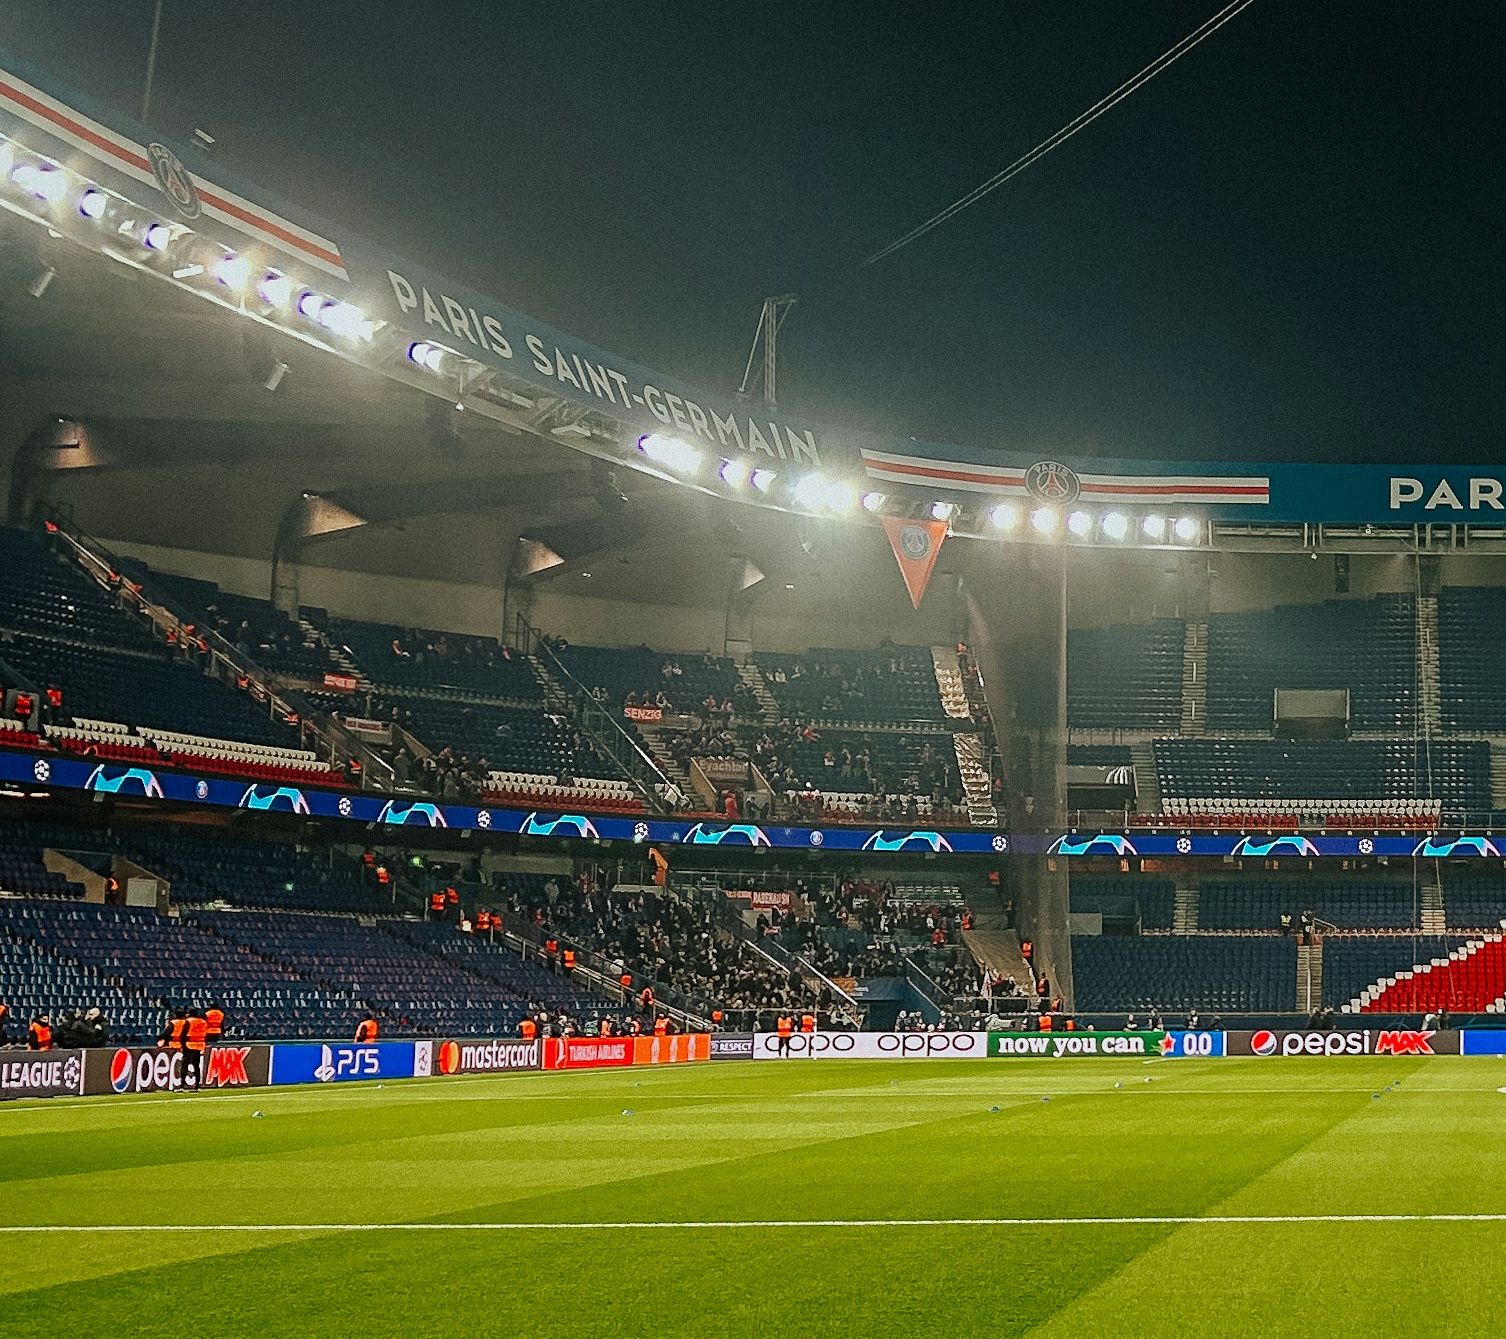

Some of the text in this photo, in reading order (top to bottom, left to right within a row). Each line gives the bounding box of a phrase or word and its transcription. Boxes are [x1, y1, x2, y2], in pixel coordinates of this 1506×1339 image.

[387, 269, 822, 467] PARIS SAINT-GERMAIN
[1034, 463, 1069, 477] PARIS
[460, 1039, 539, 1069] mastercard
[719, 1042, 752, 1052] RESPECT
[876, 1033, 975, 1056] oppo
[998, 1036, 1146, 1058] now you can
[1182, 1032, 1213, 1055] 0.0
[1282, 1030, 1437, 1056] pepsi MAX
[1, 1061, 62, 1089] LEAGUE
[205, 1047, 251, 1087] MAX
[337, 1049, 379, 1075] PS5
